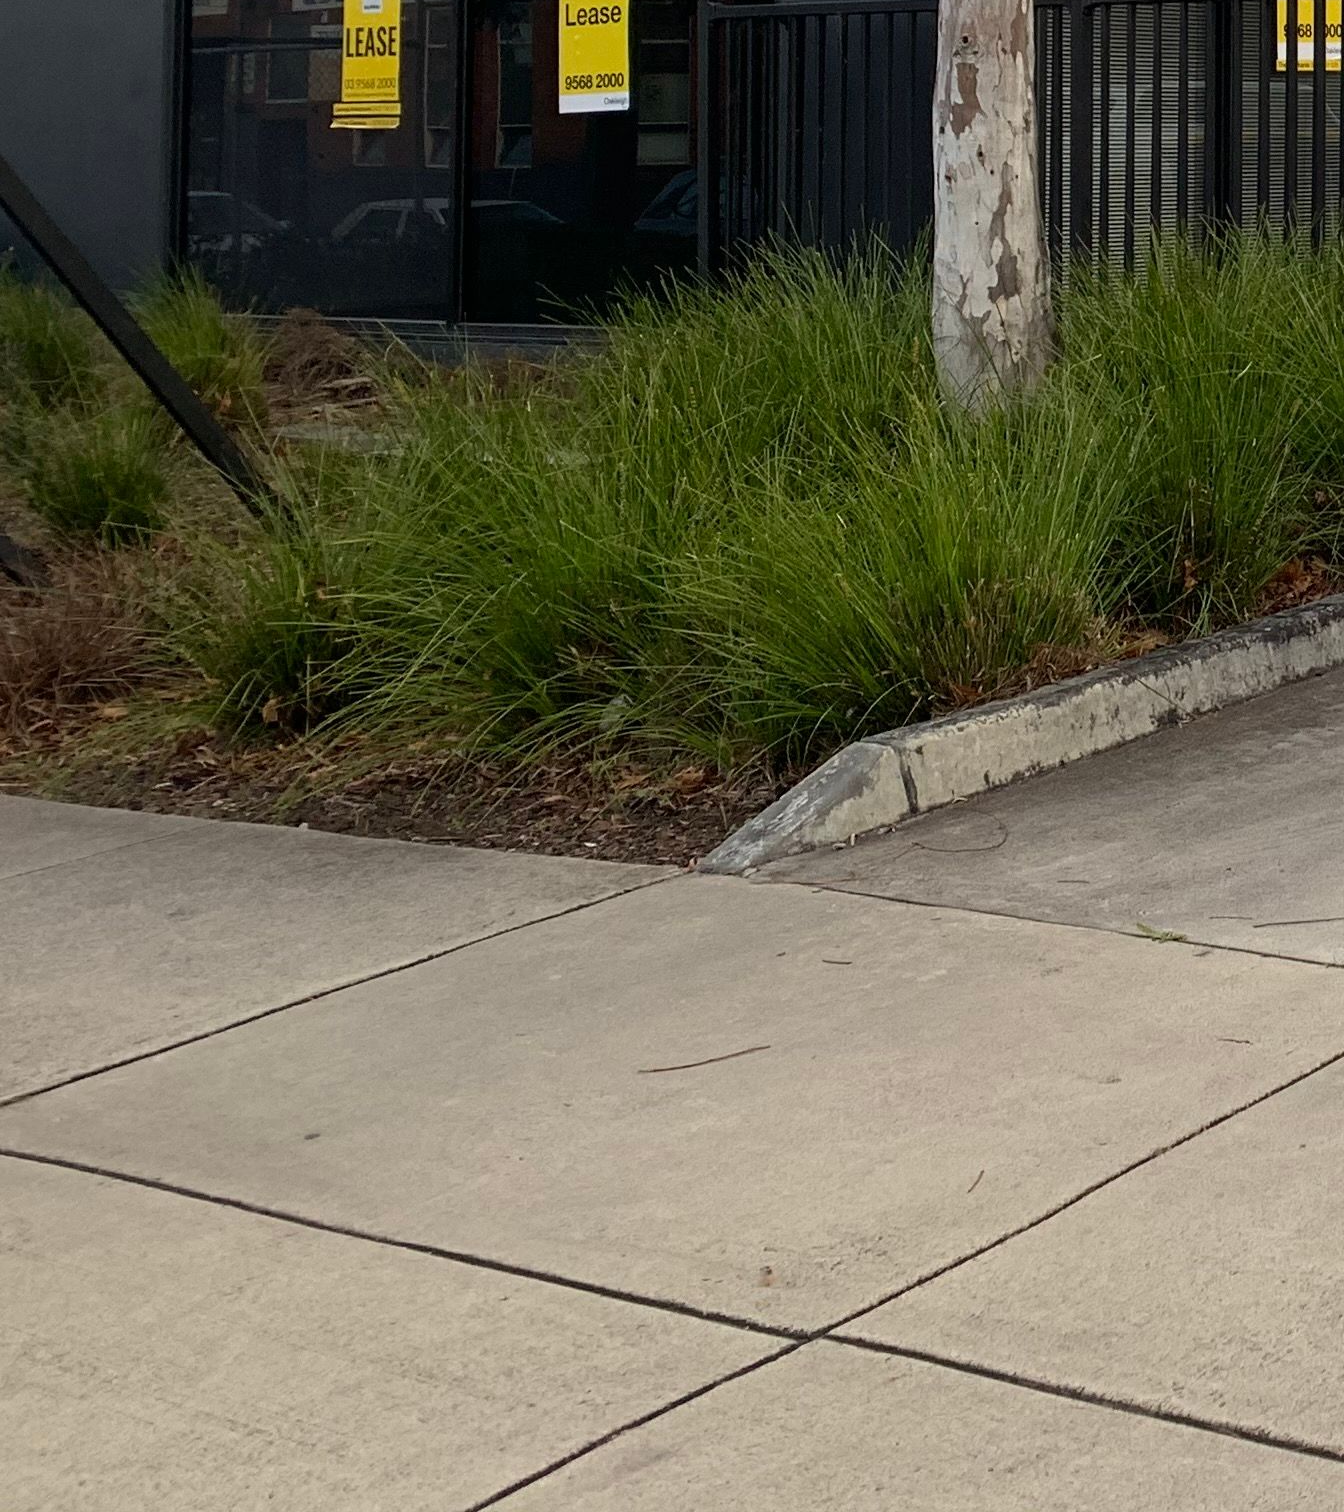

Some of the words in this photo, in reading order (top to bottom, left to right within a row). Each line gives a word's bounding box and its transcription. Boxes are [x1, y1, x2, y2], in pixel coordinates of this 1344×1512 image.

[565, 3, 622, 27] Lease
[1283, 23, 1313, 38] 968
[345, 26, 398, 58] LEASE
[565, 75, 593, 90] 9568
[596, 72, 624, 88] 2000
